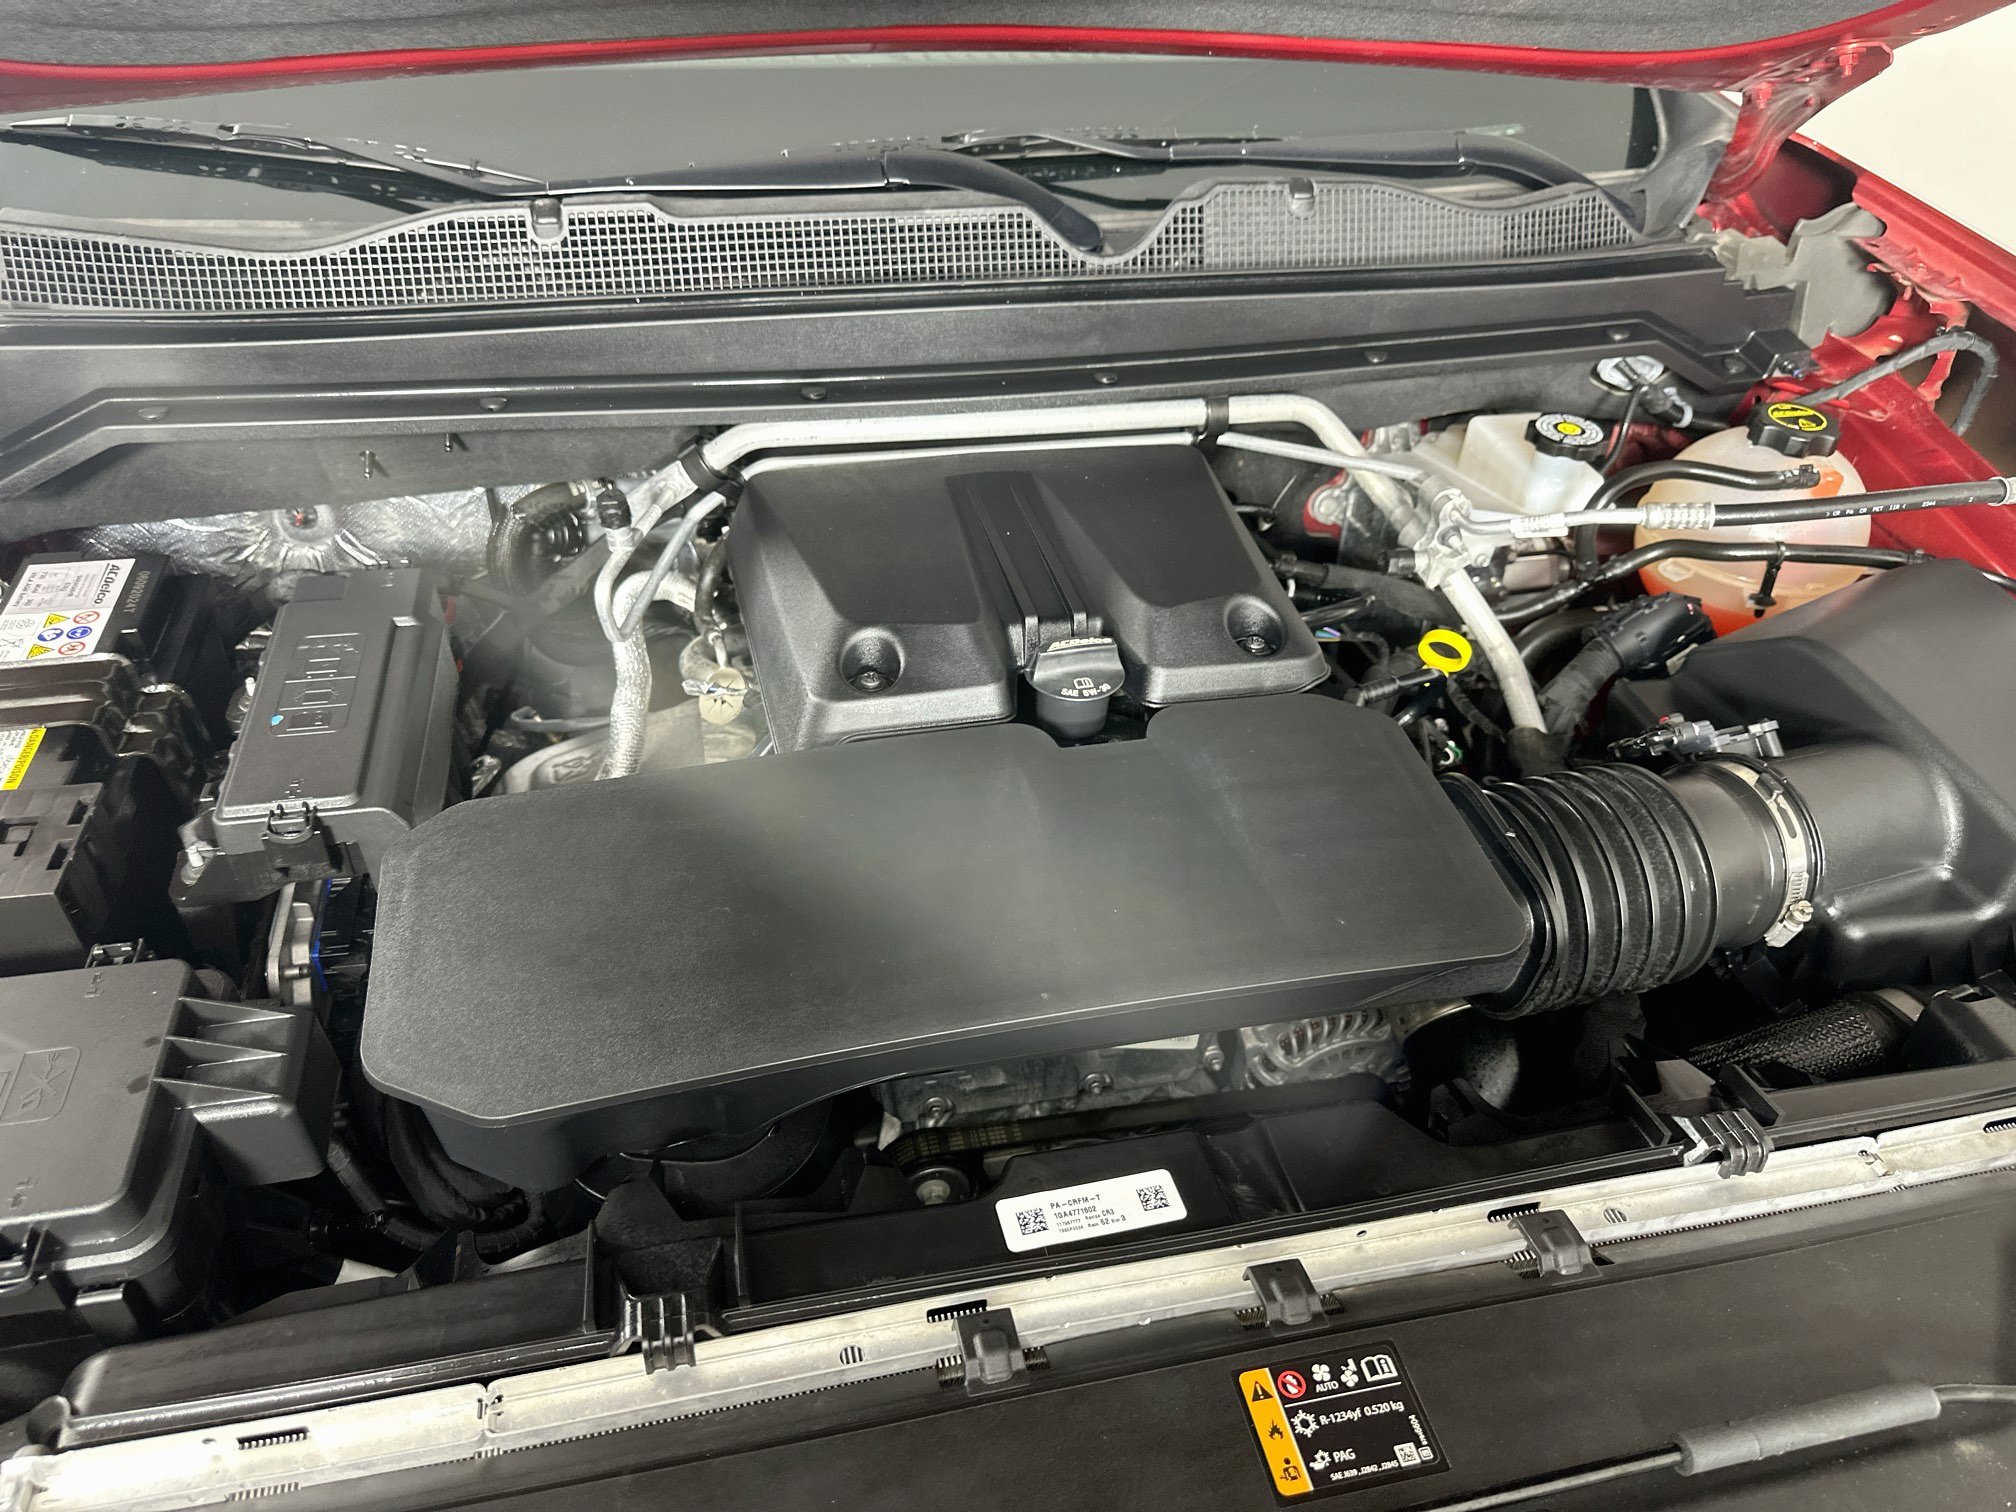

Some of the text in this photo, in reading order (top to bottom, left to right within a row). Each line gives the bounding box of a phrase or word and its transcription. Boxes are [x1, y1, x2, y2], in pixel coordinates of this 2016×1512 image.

[94, 564, 120, 605] ACDelco
[1047, 637, 1112, 651] ACDelco
[1060, 688, 1079, 697] SAE
[1315, 1380, 1339, 1393] AUTO
[1319, 1400, 1405, 1426] R-1234yf 0.520 kg
[1332, 1448, 1356, 1463] PAG
[1330, 1470, 1343, 1481] SAE
